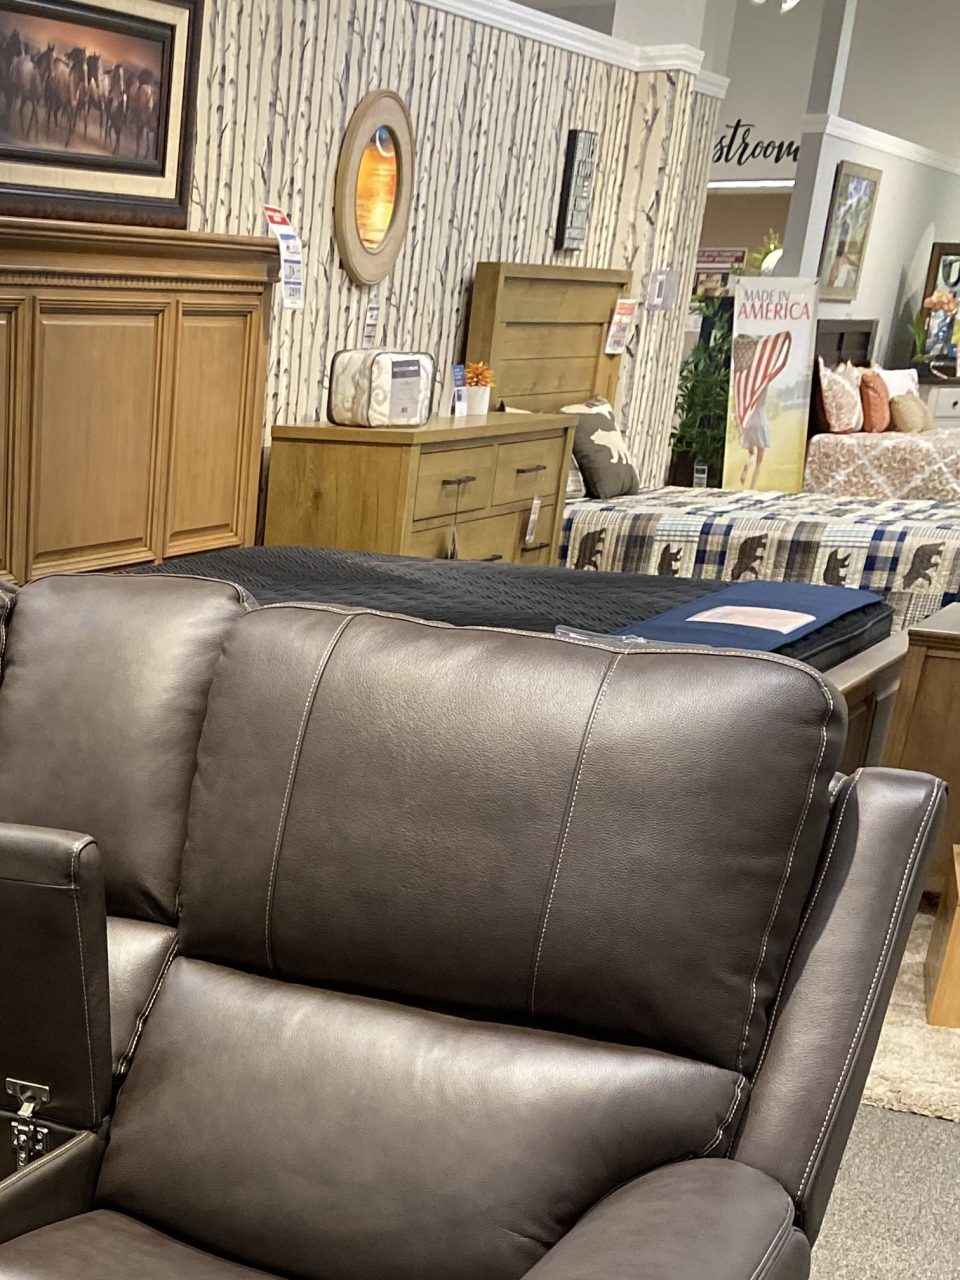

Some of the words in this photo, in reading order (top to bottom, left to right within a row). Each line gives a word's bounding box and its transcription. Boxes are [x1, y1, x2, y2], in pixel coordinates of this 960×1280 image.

[743, 289, 774, 302] MADE
[778, 289, 791, 302] IN
[737, 301, 810, 320] AMERICA
